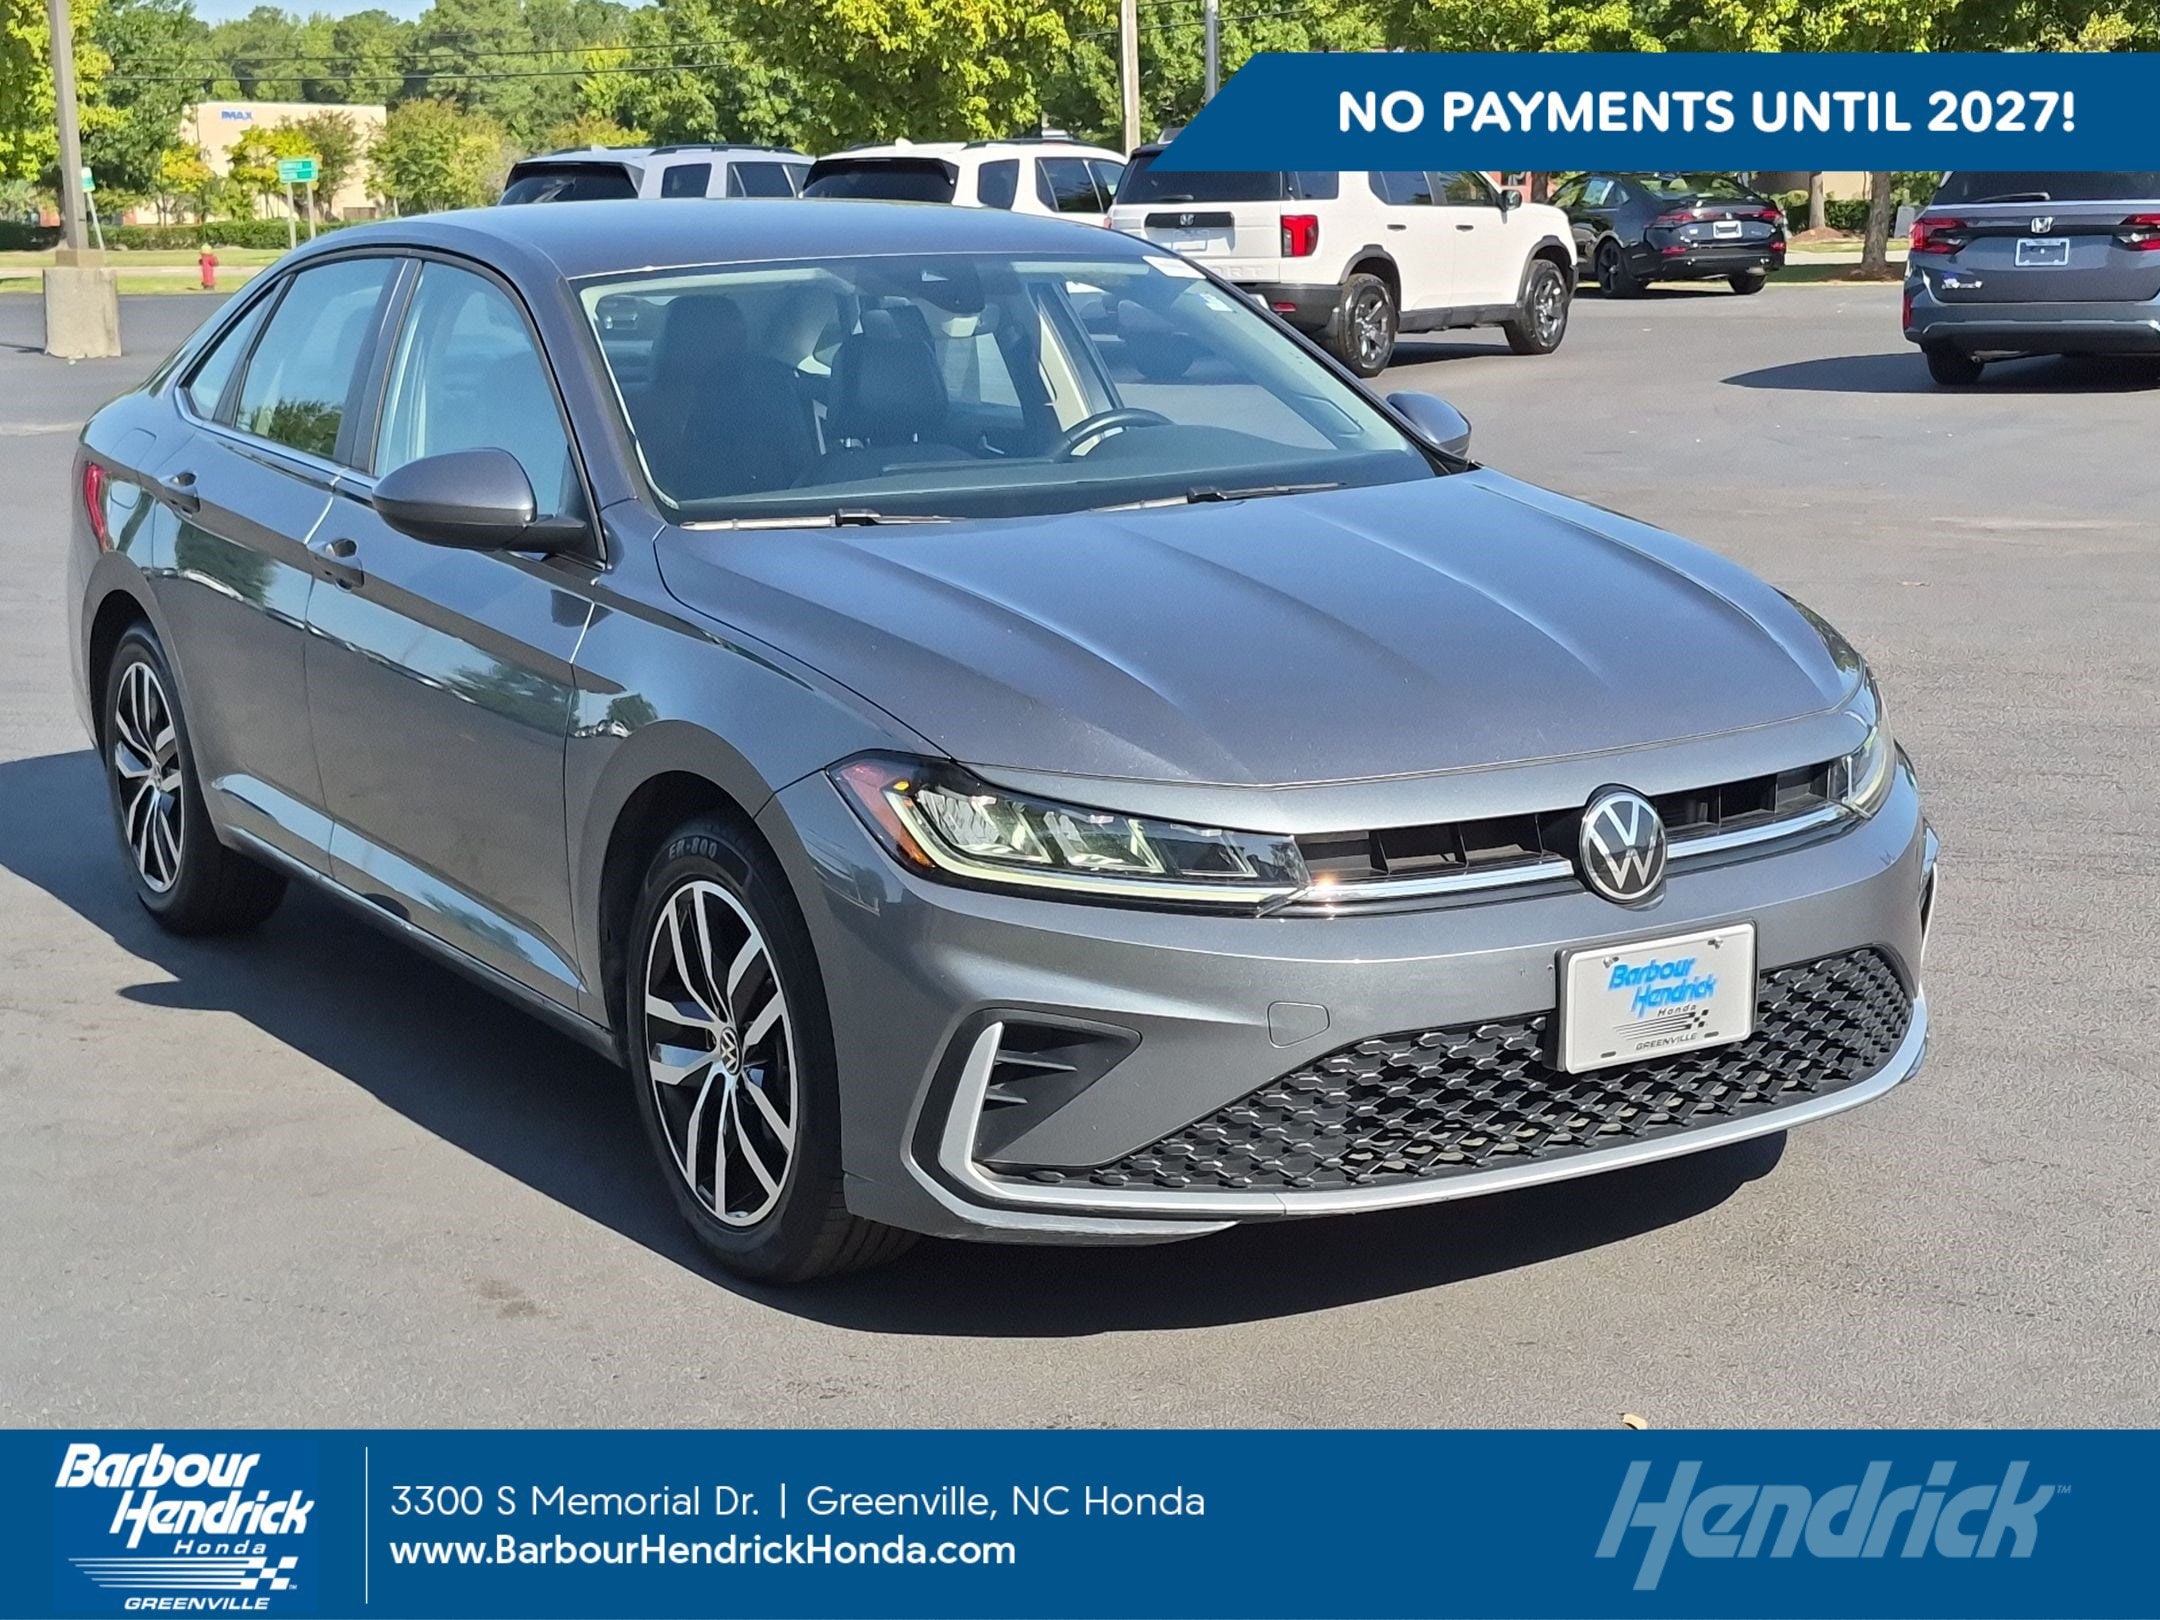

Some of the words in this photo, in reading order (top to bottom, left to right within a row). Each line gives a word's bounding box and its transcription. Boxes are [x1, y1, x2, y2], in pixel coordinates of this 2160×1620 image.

[221, 110, 253, 121] IMAX
[1608, 957, 1697, 991] Barbour
[1630, 973, 1718, 1019] Hendrick
[1657, 1003, 1697, 1017] Honda
[1635, 1032, 1698, 1051] GREENVILLE
